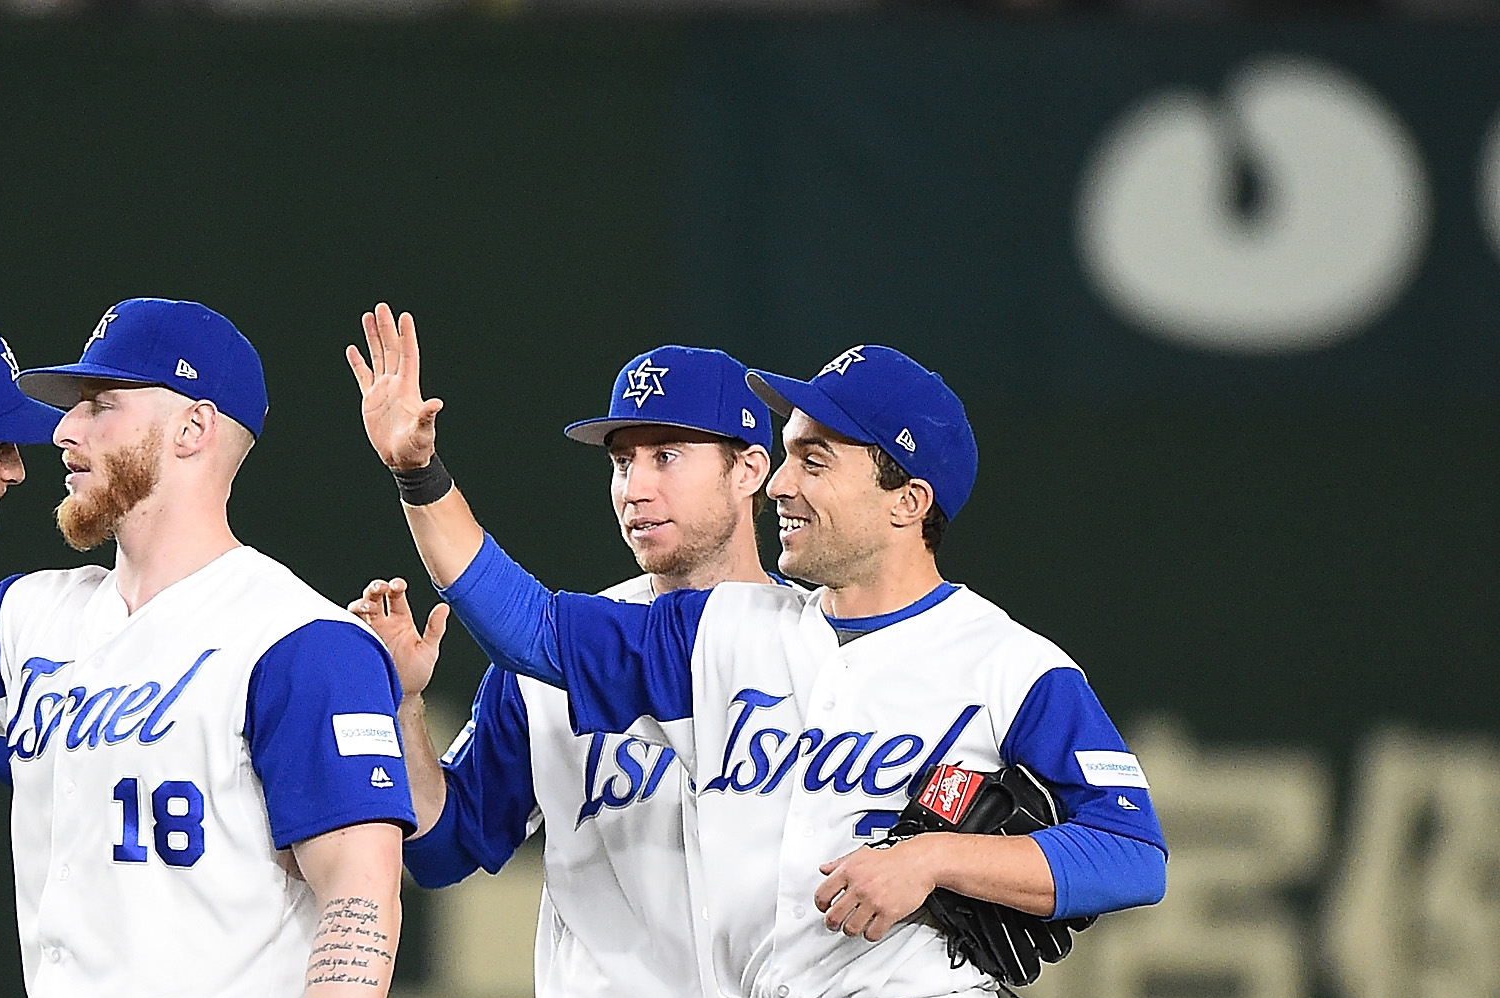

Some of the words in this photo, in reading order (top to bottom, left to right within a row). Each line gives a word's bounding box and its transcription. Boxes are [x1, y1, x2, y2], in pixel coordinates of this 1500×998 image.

[6, 648, 220, 762] Israel
[699, 687, 984, 800] Israel
[110, 775, 207, 870] 18
